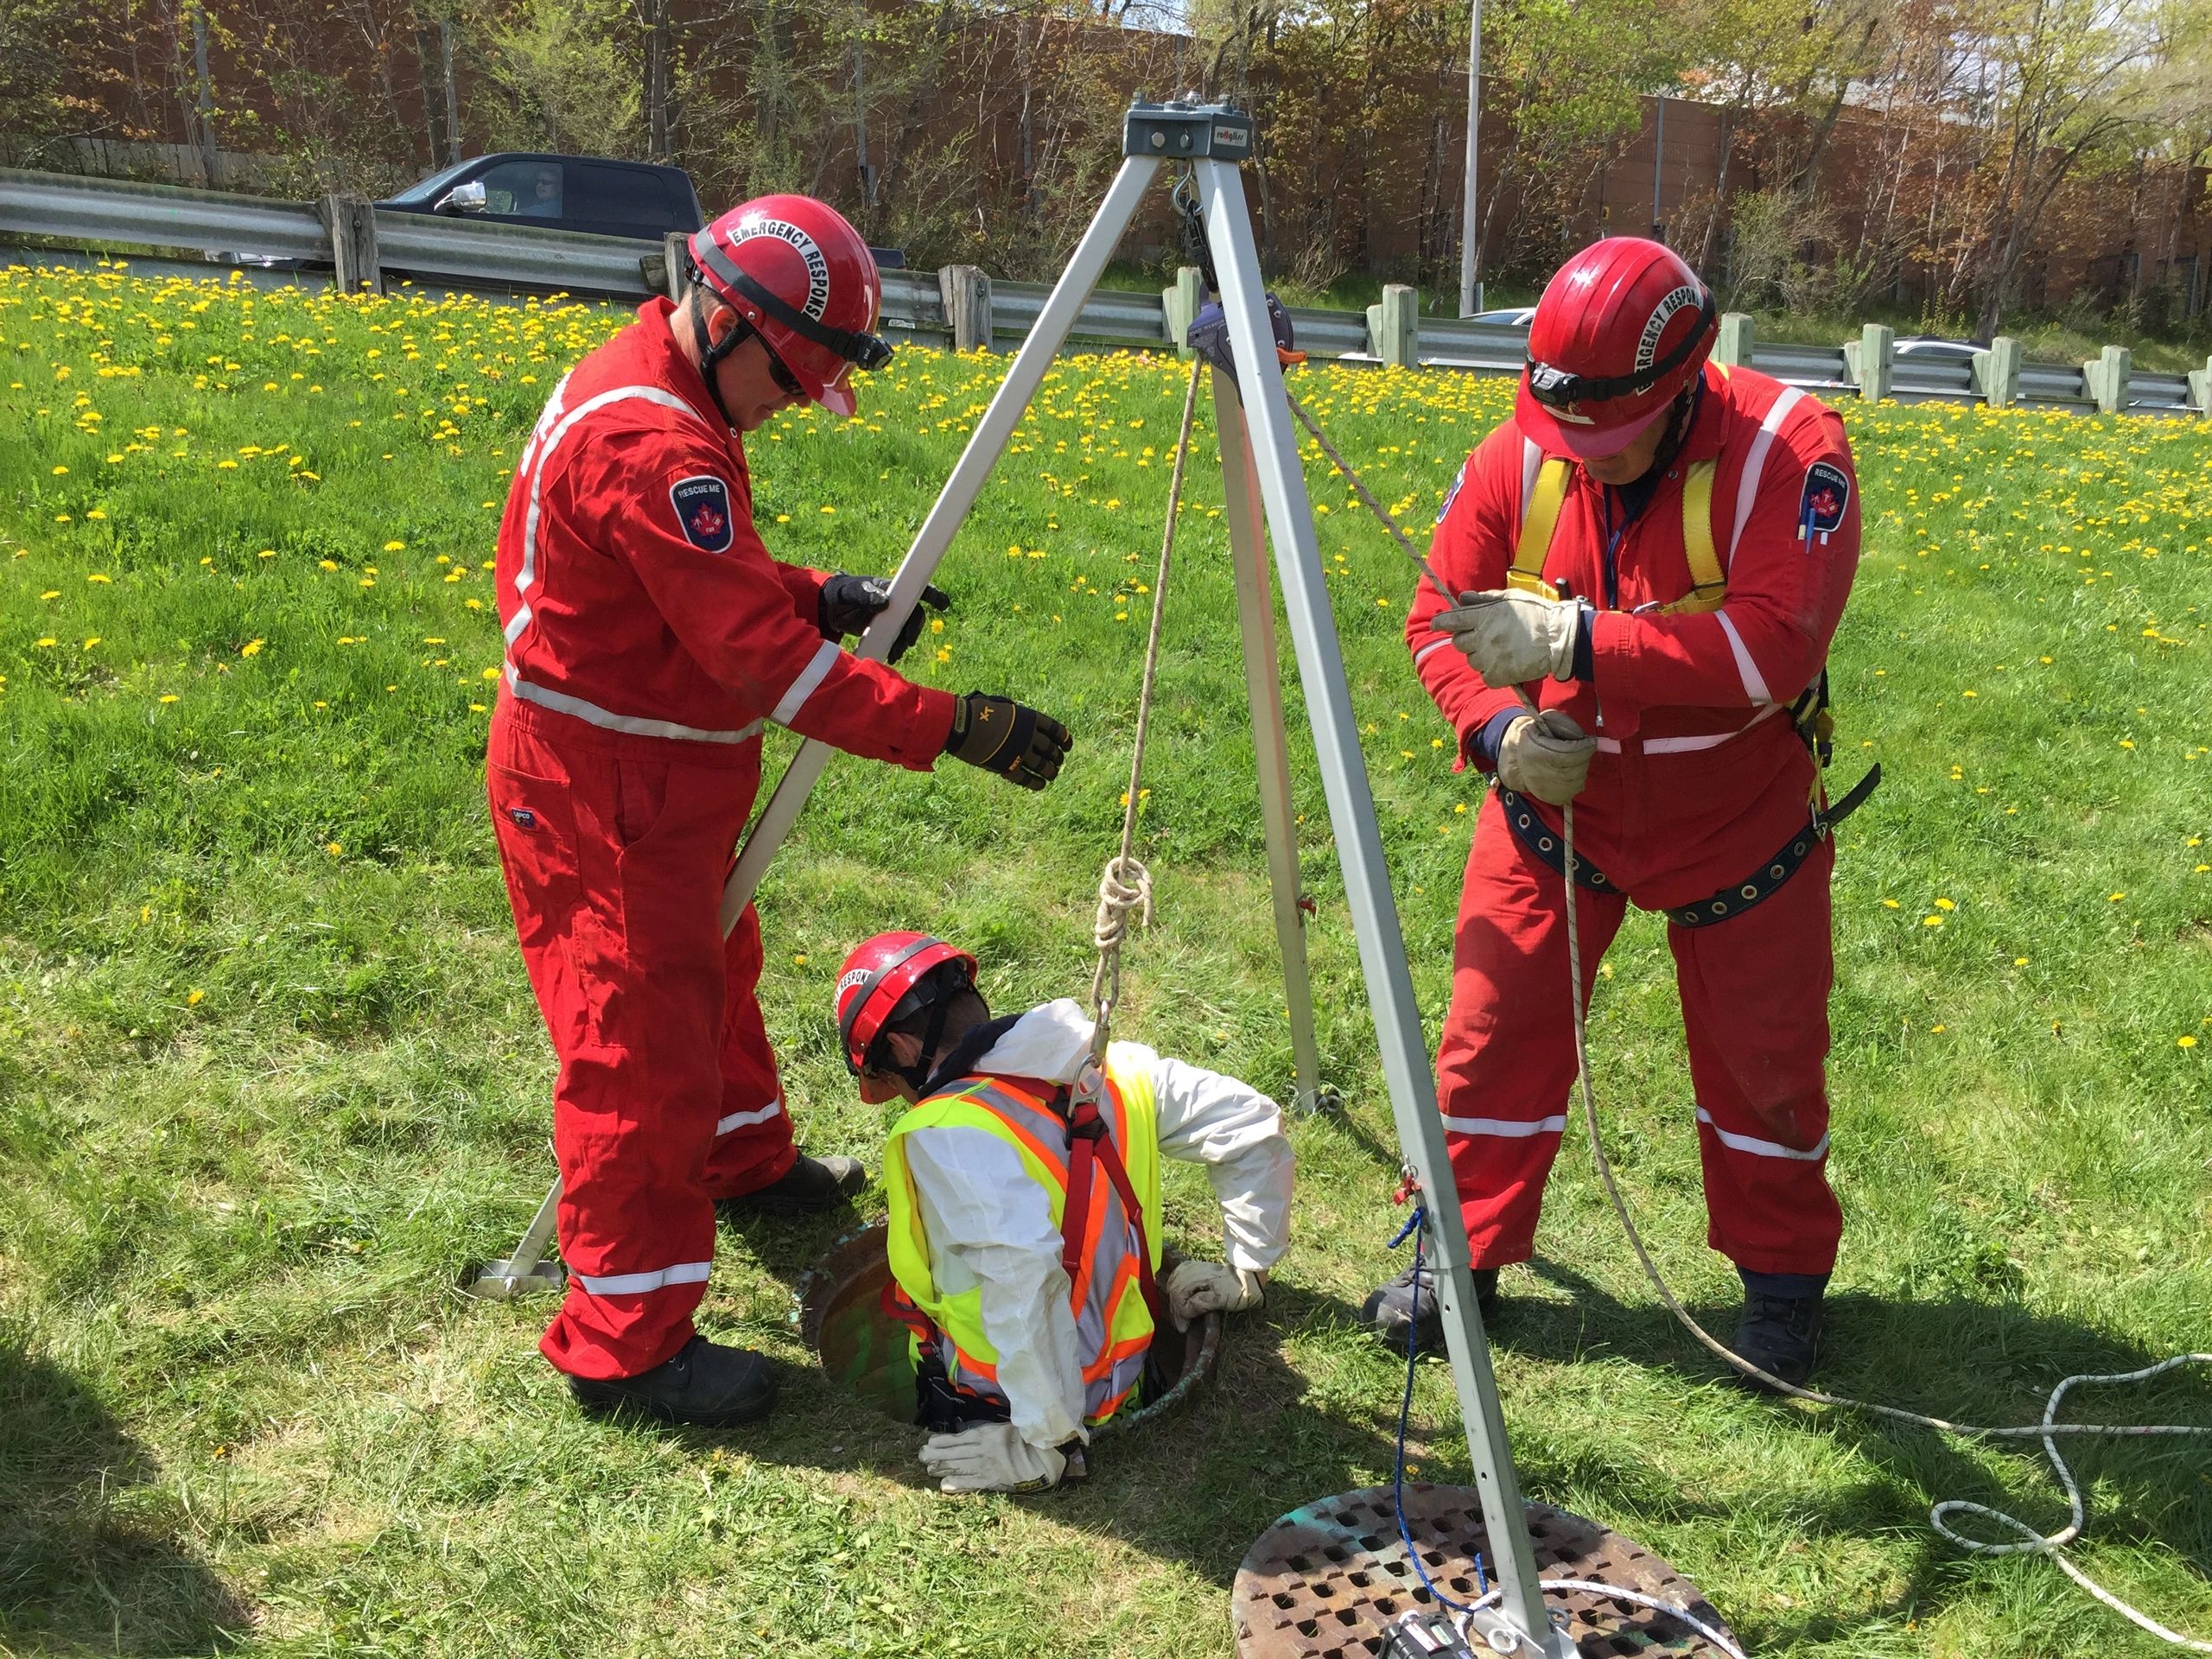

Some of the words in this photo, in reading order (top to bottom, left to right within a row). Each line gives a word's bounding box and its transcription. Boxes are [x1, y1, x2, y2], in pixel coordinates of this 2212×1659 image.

[732, 221, 812, 250] EMERGENCY
[804, 251, 828, 318] RESPONS
[1815, 468, 1839, 482] RESCUE
[677, 485, 709, 499] RESCUE
[709, 484, 721, 493] ME
[979, 705, 995, 721] XT
[840, 969, 872, 991] RESPON
